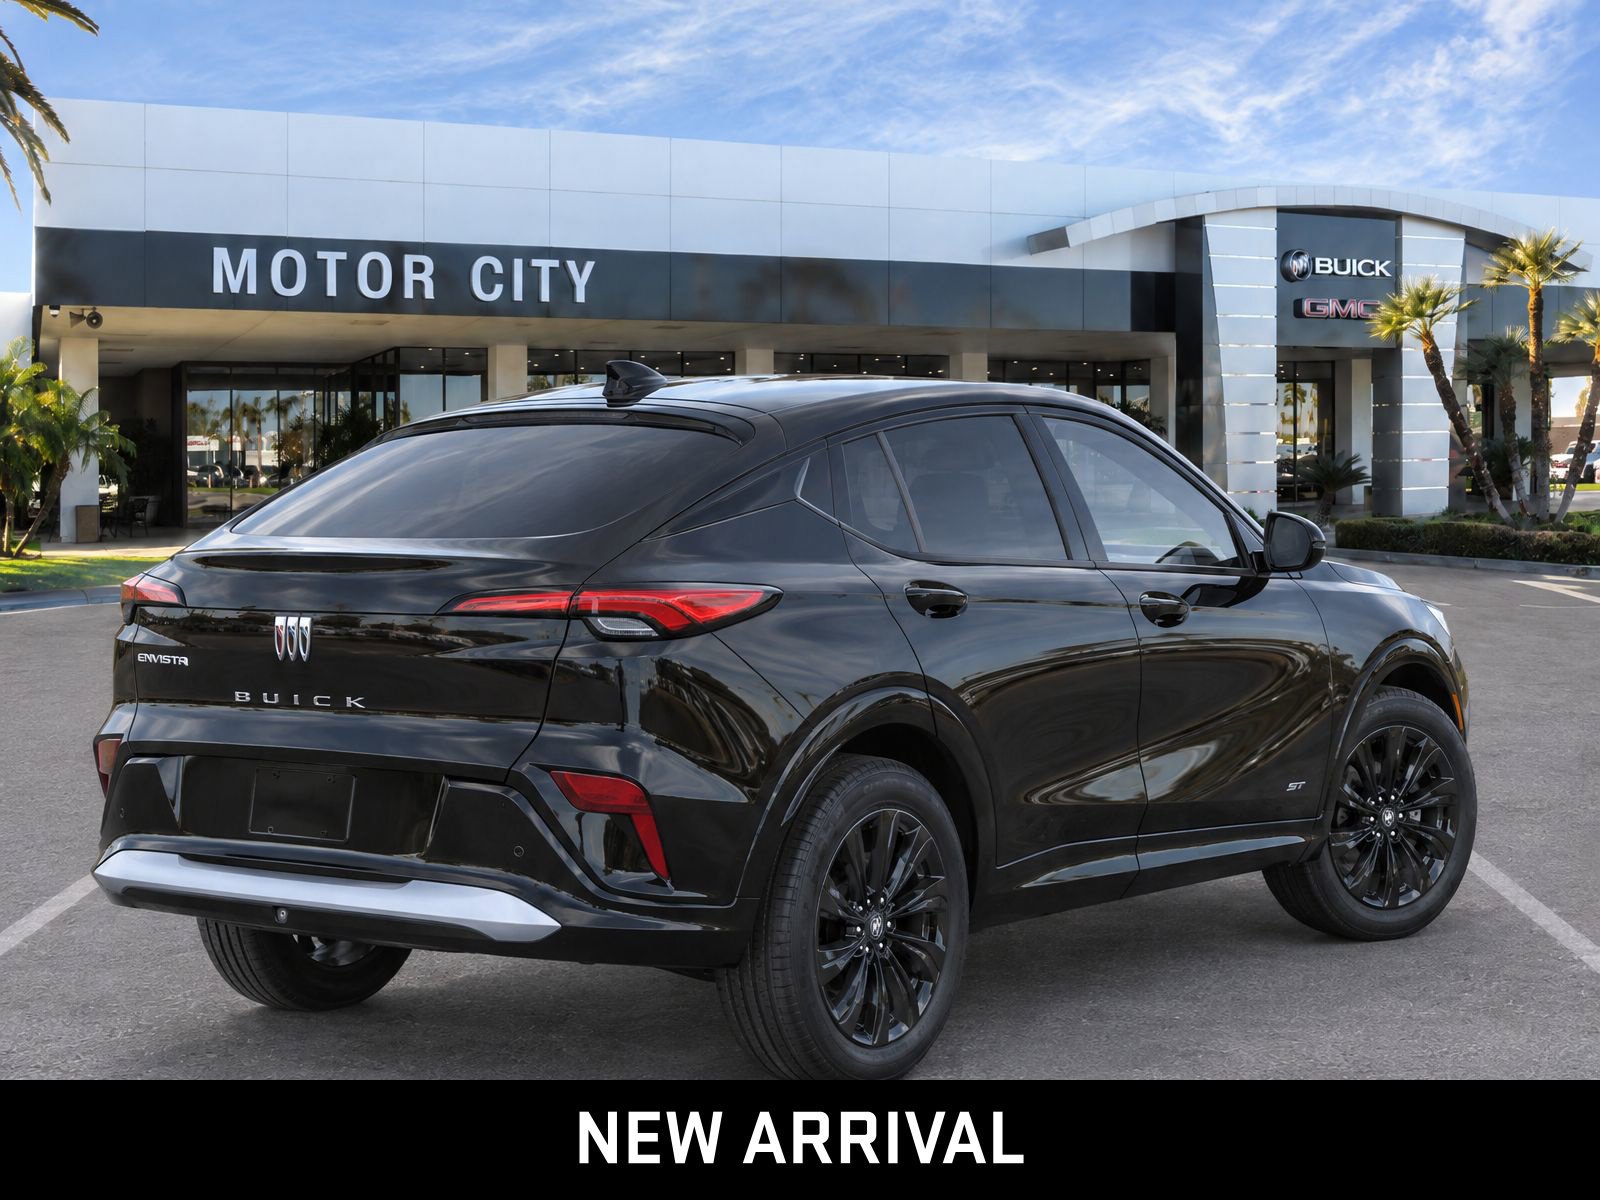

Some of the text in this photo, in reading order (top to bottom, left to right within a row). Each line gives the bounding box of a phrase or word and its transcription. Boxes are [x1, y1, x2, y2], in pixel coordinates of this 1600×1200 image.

[212, 246, 596, 303] MOTOR CITY
[1315, 257, 1392, 276] BUICK
[1304, 298, 1381, 318] GMC
[137, 653, 189, 666] ENVISTA
[234, 691, 365, 708] BUICK
[1286, 781, 1306, 791] ST
